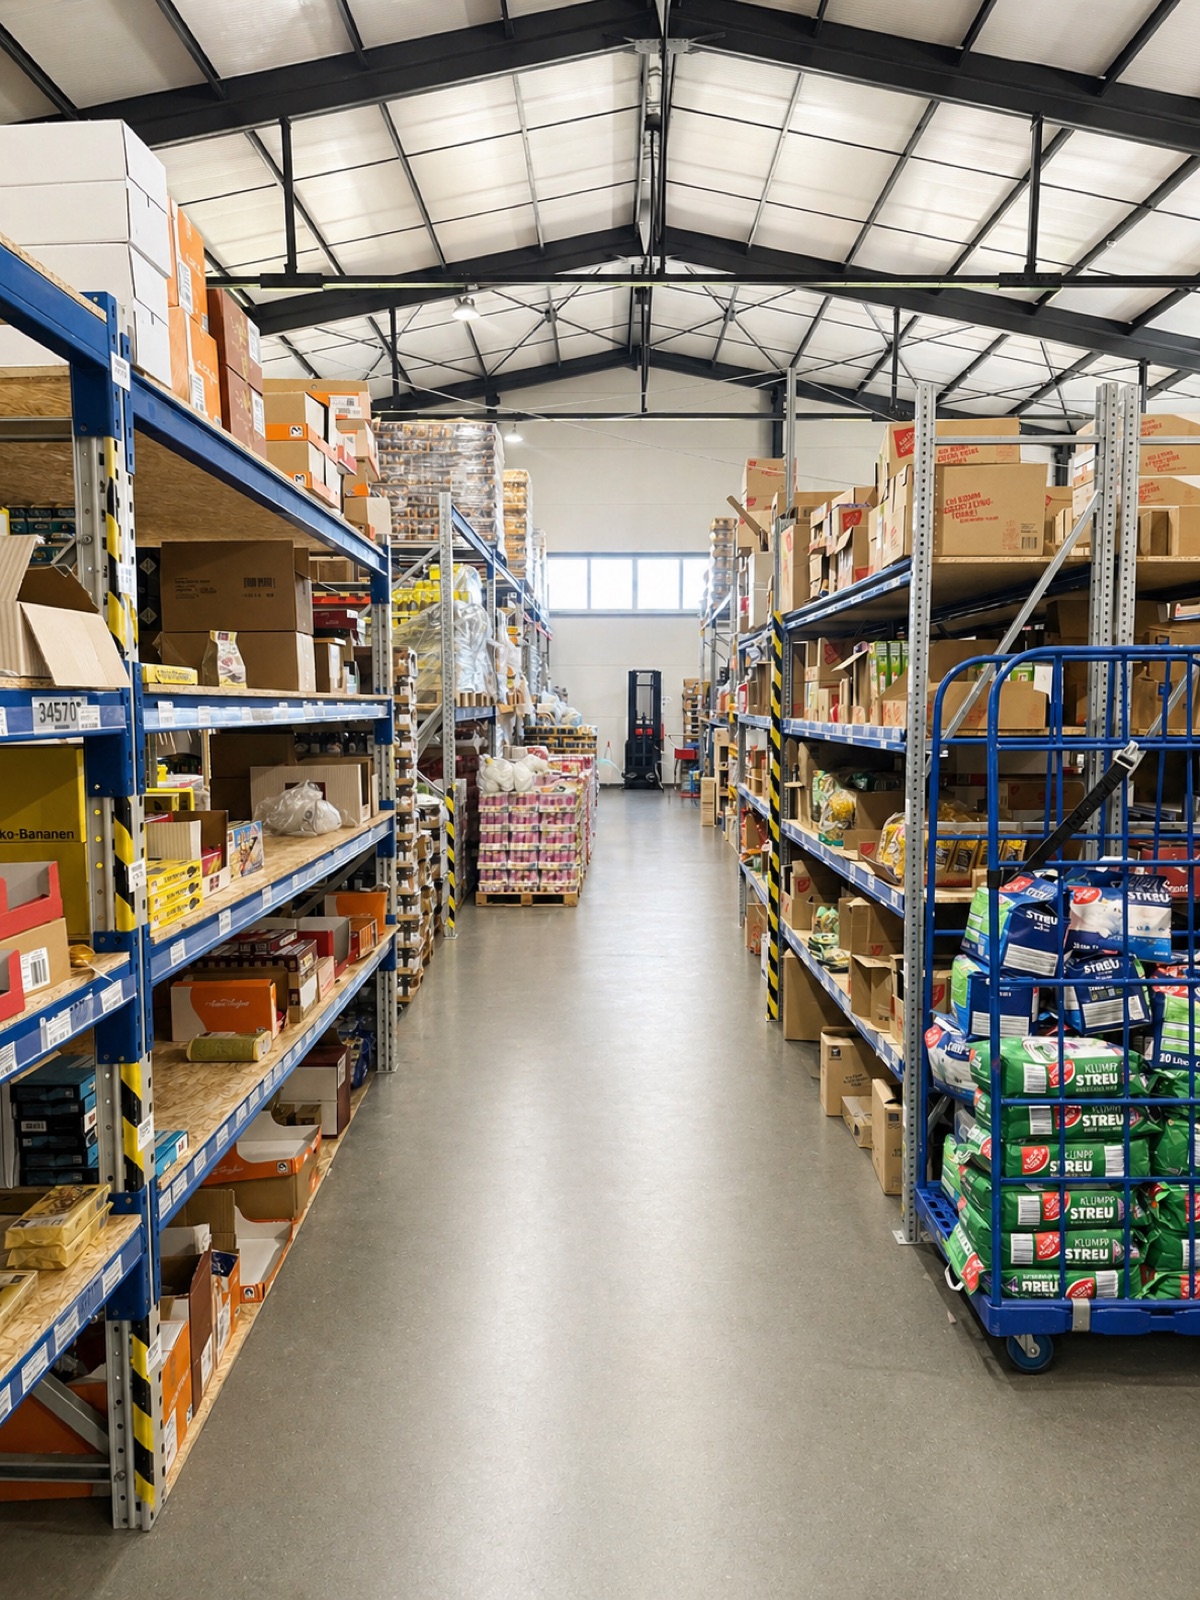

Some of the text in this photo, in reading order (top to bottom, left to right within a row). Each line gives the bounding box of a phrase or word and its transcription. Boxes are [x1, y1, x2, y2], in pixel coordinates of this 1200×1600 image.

[1075, 1073, 1118, 1086] STREU
[1082, 1114, 1124, 1127] STREU
[1049, 1160, 1093, 1172] SREU
[1080, 1196, 1115, 1206] KLUMPP
[1070, 1207, 1114, 1220] STREU
[1074, 1238, 1109, 1247] KLUMPP
[1065, 1248, 1109, 1260] STREU
